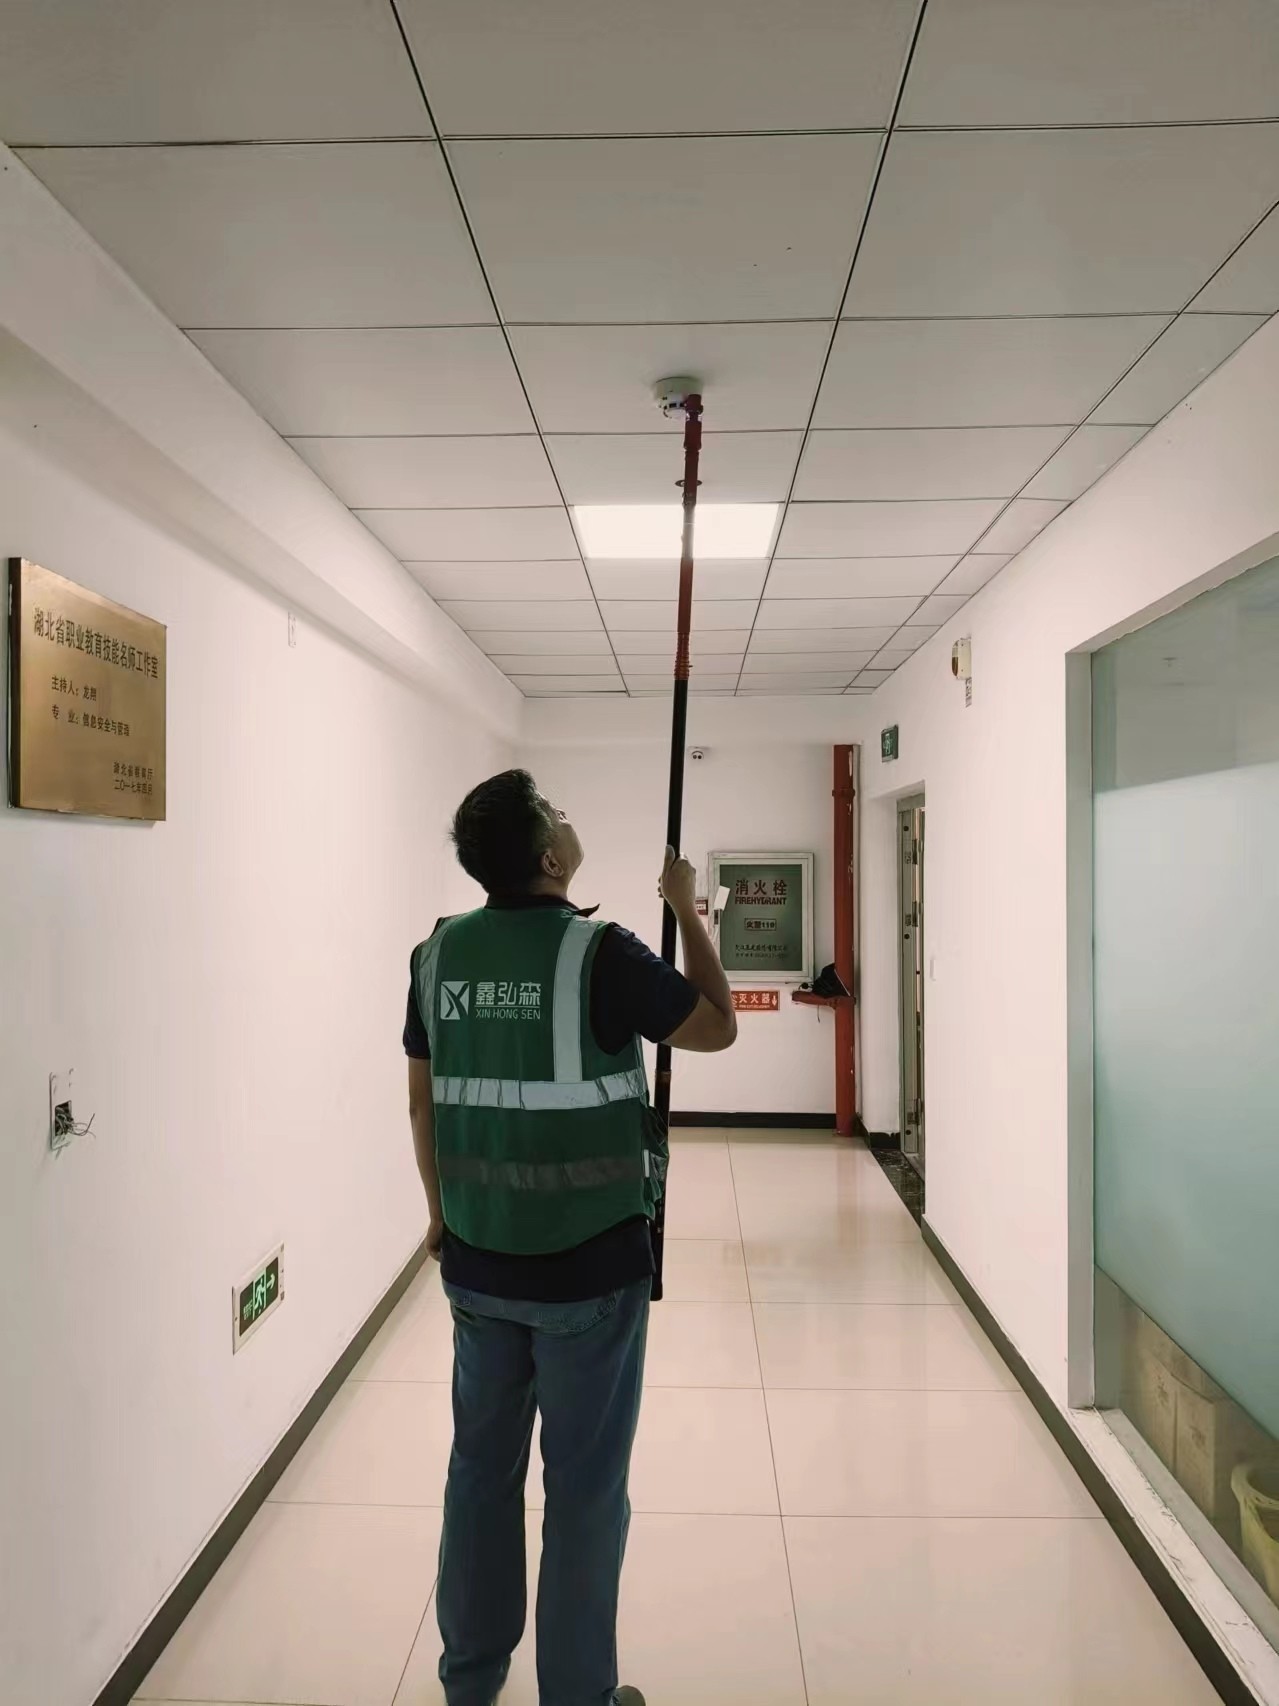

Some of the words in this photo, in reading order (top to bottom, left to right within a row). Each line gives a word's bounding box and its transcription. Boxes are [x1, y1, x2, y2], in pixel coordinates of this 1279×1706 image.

[34, 607, 159, 679] 湖北省职业教育技能名师工作室
[735, 879, 788, 896] 消火栓
[475, 981, 541, 1006] 鑫弘森
[738, 993, 771, 1004] 灭火器
[475, 1008, 491, 1019] XIN
[492, 1008, 519, 1020] HONG
[520, 1009, 541, 1020] SEN
